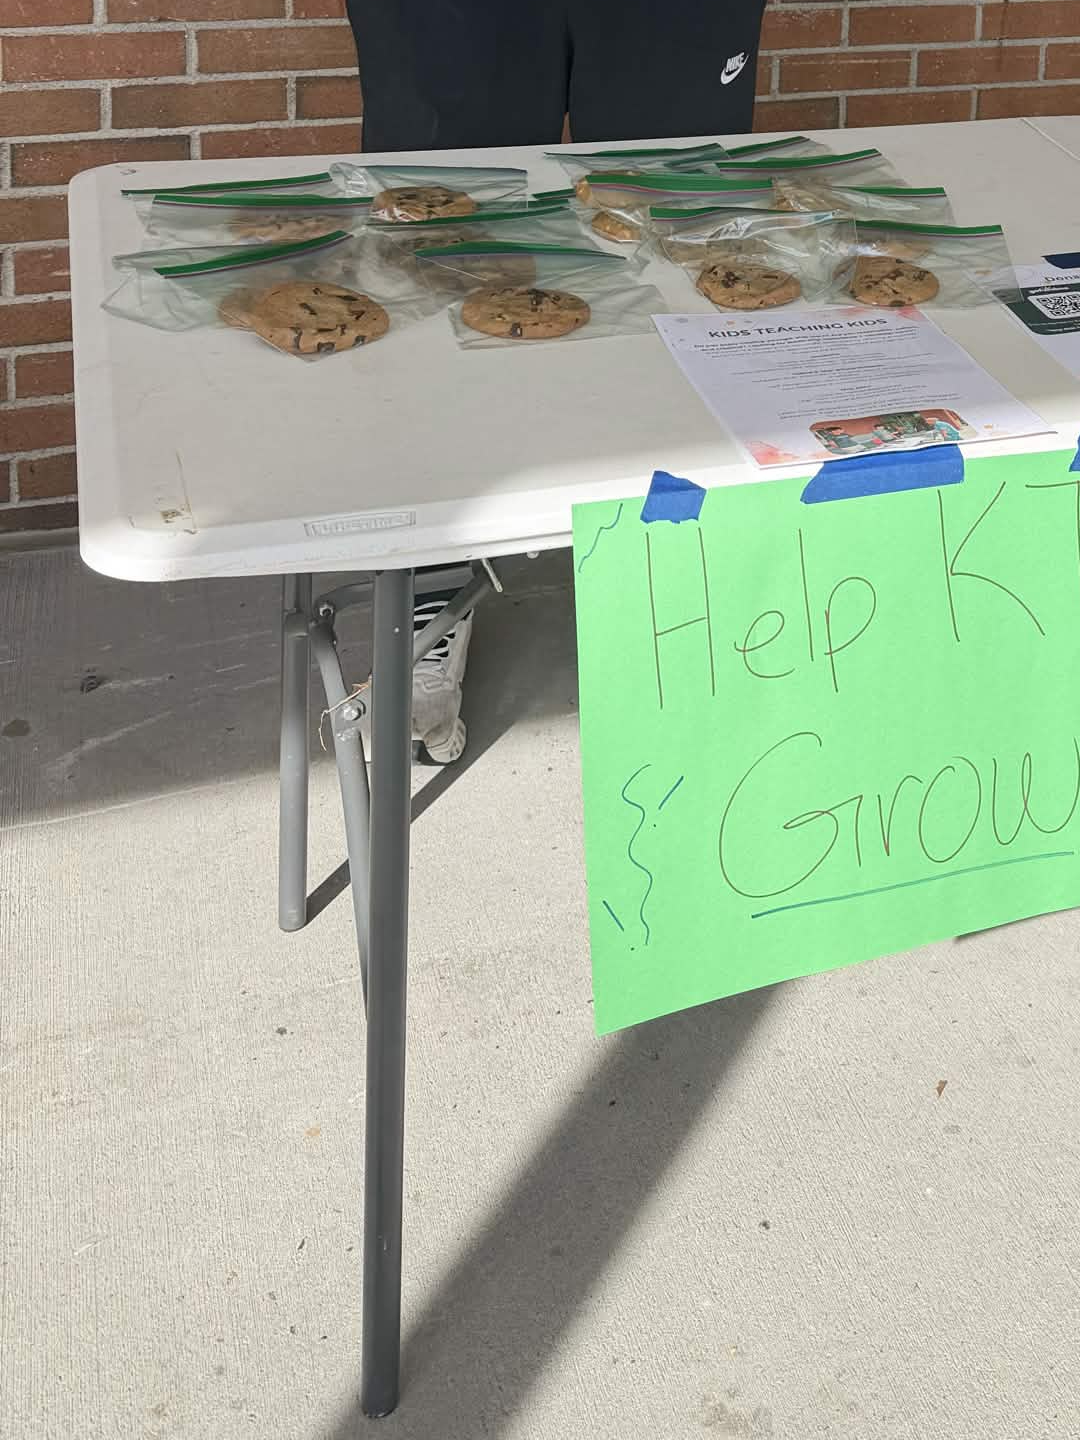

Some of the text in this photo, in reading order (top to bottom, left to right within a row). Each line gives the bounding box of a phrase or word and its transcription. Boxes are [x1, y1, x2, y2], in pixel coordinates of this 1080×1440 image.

[708, 318, 888, 339] KIDS TEACHING KIDS
[645, 526, 878, 710] Help
